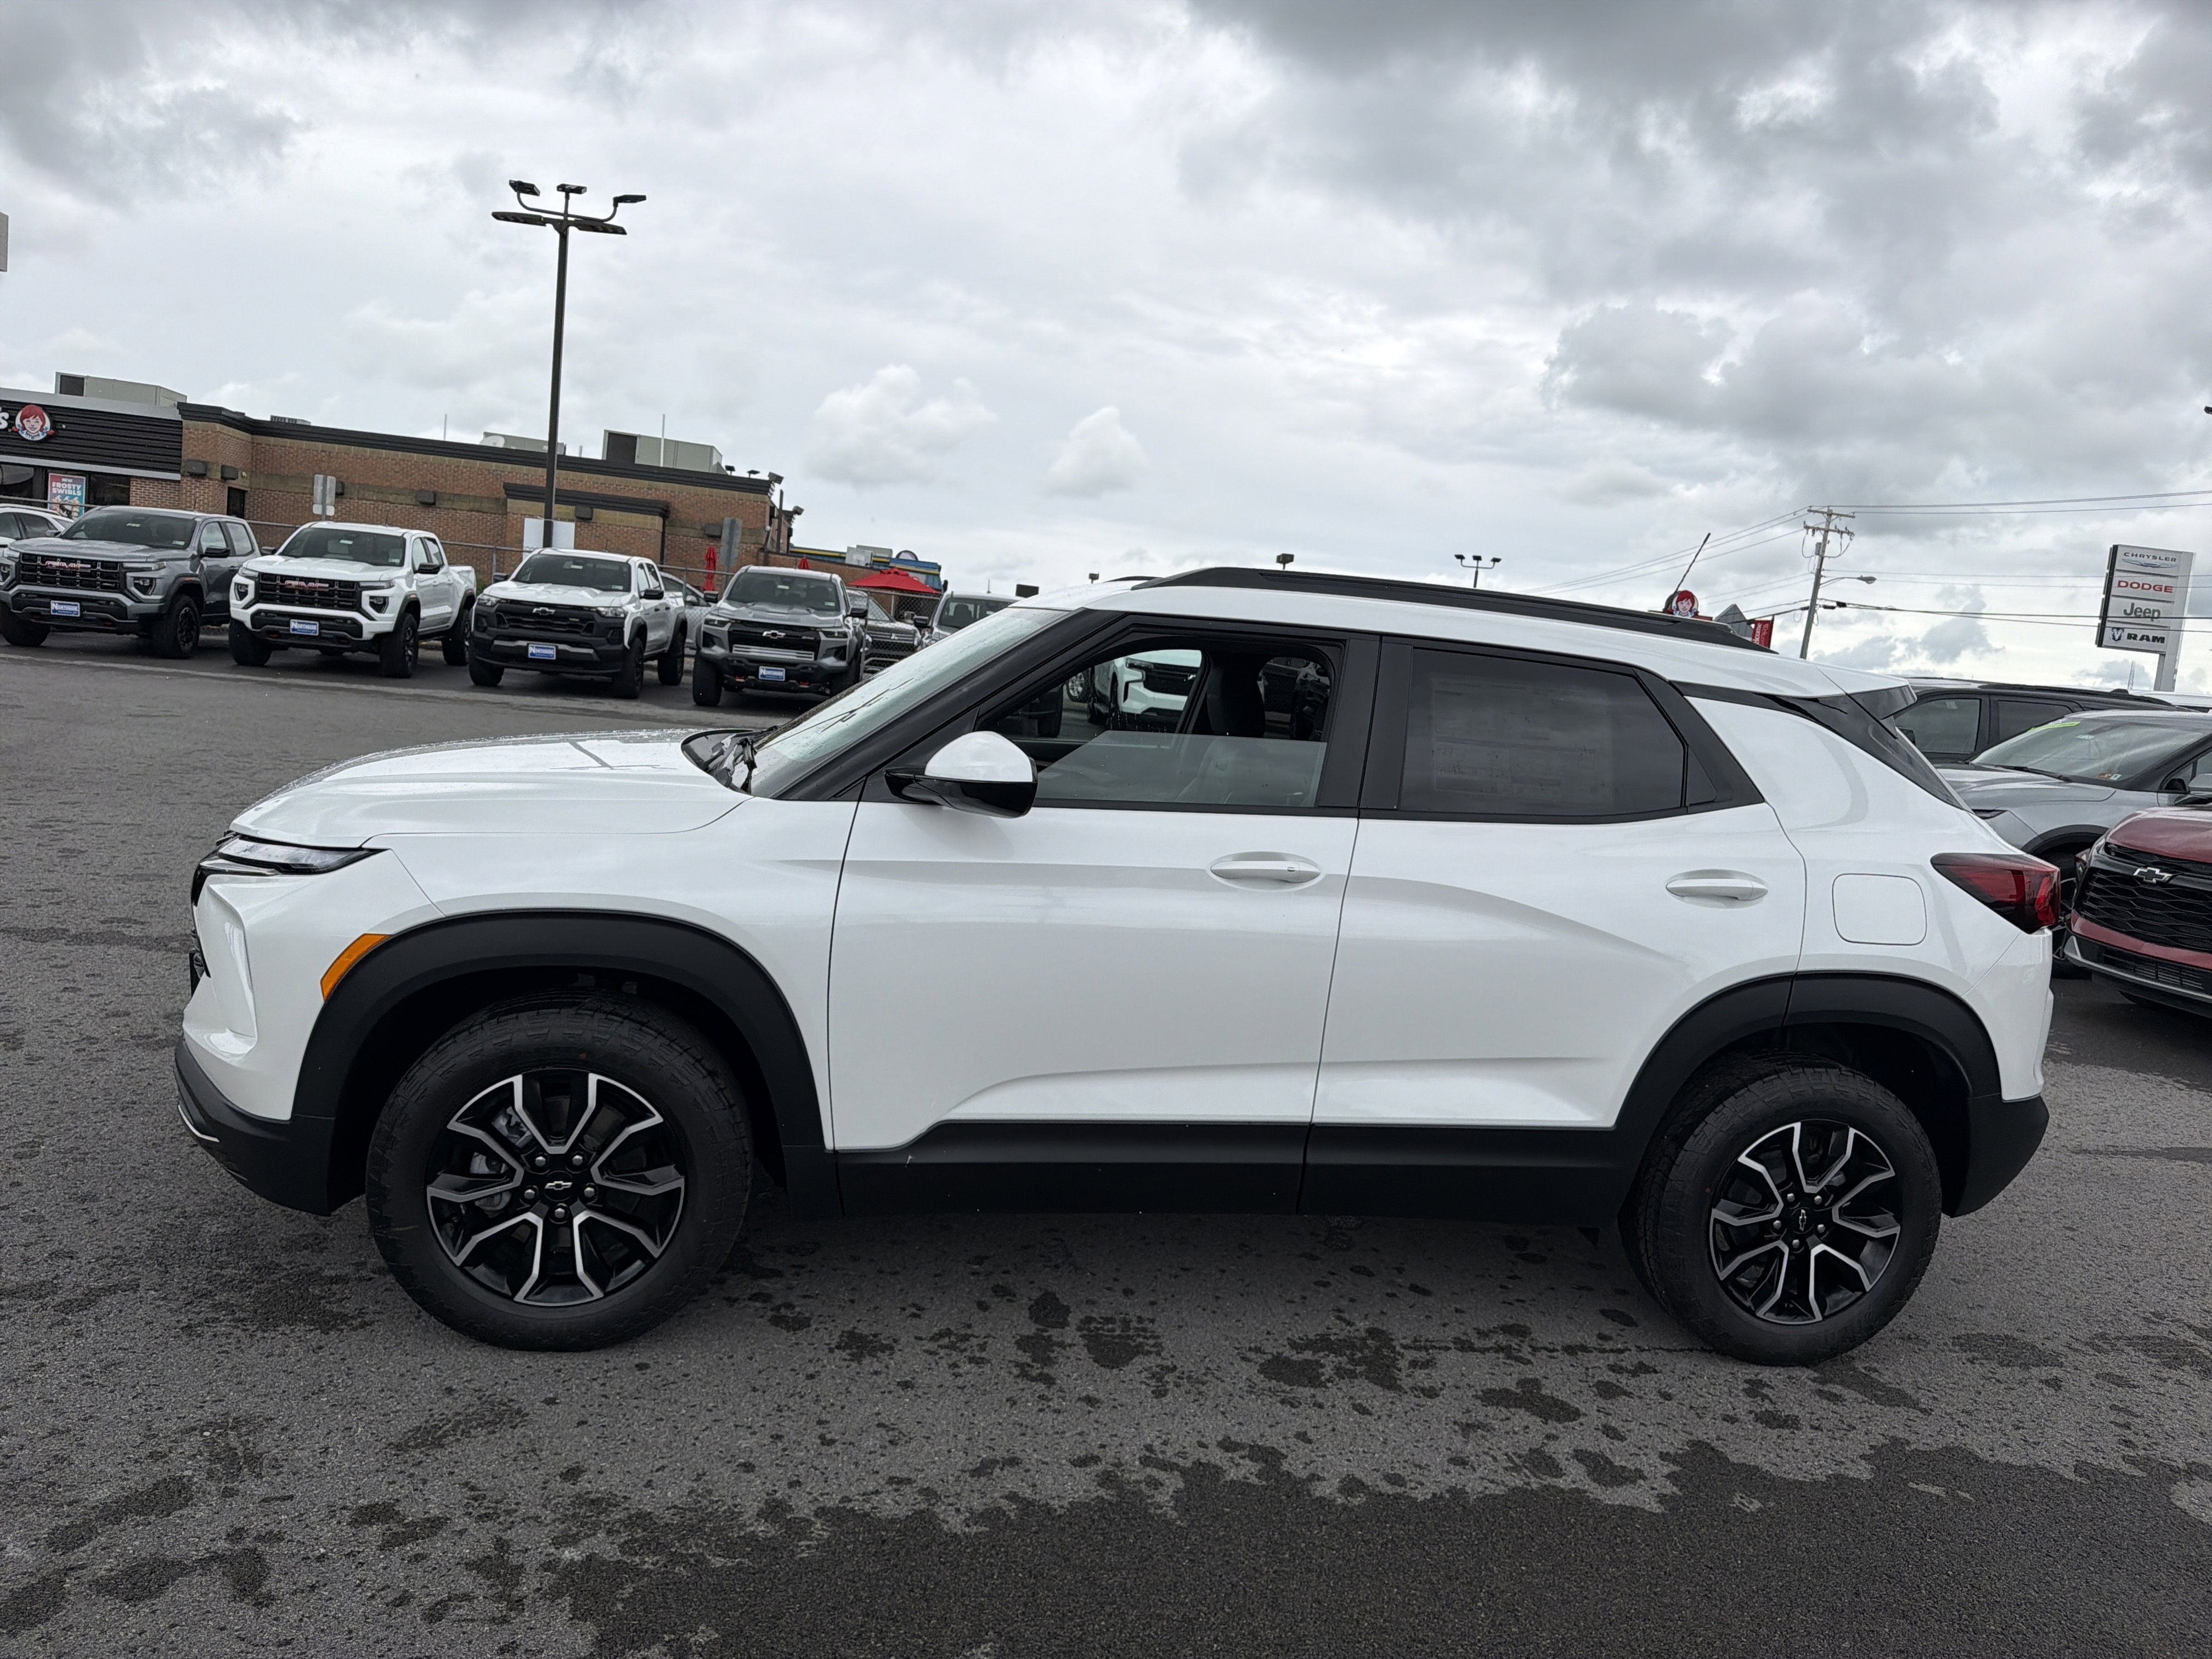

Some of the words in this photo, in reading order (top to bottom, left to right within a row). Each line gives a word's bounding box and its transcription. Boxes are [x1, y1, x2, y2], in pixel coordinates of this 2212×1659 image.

[52, 482, 82, 490] FROSTY
[52, 488, 81, 496] SWIRLS
[2123, 552, 2177, 562] CHRYSLER
[45, 561, 91, 573] GMC
[284, 580, 329, 591] GMC
[2117, 580, 2174, 594] DODGE
[2123, 602, 2161, 622] Jeep
[2126, 633, 2165, 644] RAM
